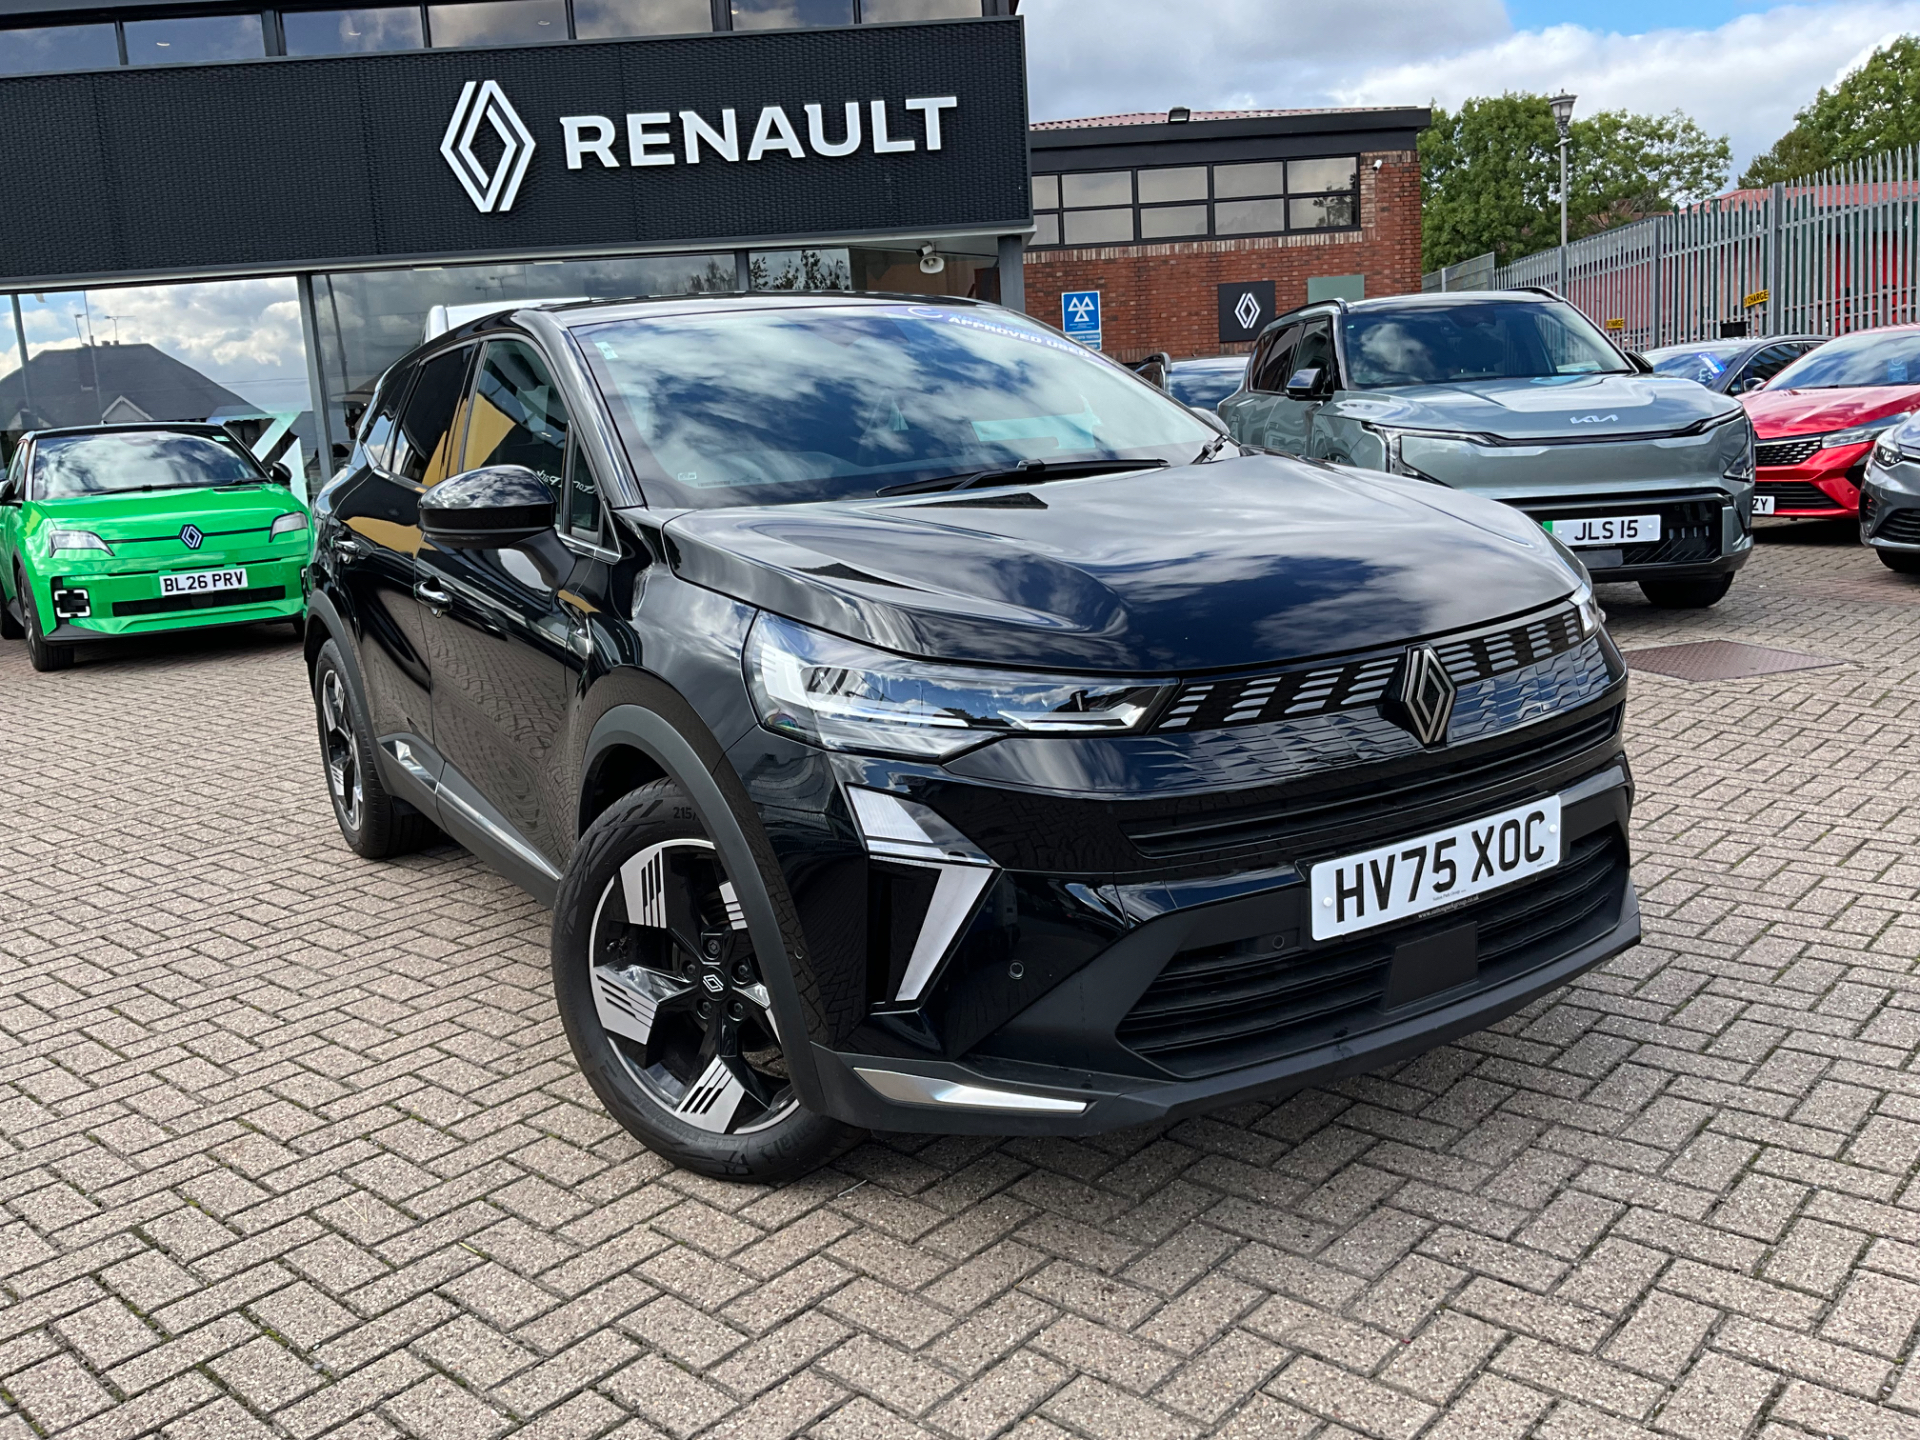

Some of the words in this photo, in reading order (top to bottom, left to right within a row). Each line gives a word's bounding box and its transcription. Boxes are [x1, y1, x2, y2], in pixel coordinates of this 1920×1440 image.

[559, 95, 958, 170] RENAULT
[948, 317, 1042, 343] APPROVED
[1046, 340, 1090, 358] USED
[1570, 414, 1618, 424] KIA
[1574, 520, 1614, 541] JLS
[1620, 519, 1639, 539] 15
[163, 575, 208, 593] BL26
[212, 570, 243, 588] PRV
[673, 806, 701, 822] 215/
[1335, 836, 1457, 924] HV75
[1471, 810, 1545, 883] XOC
